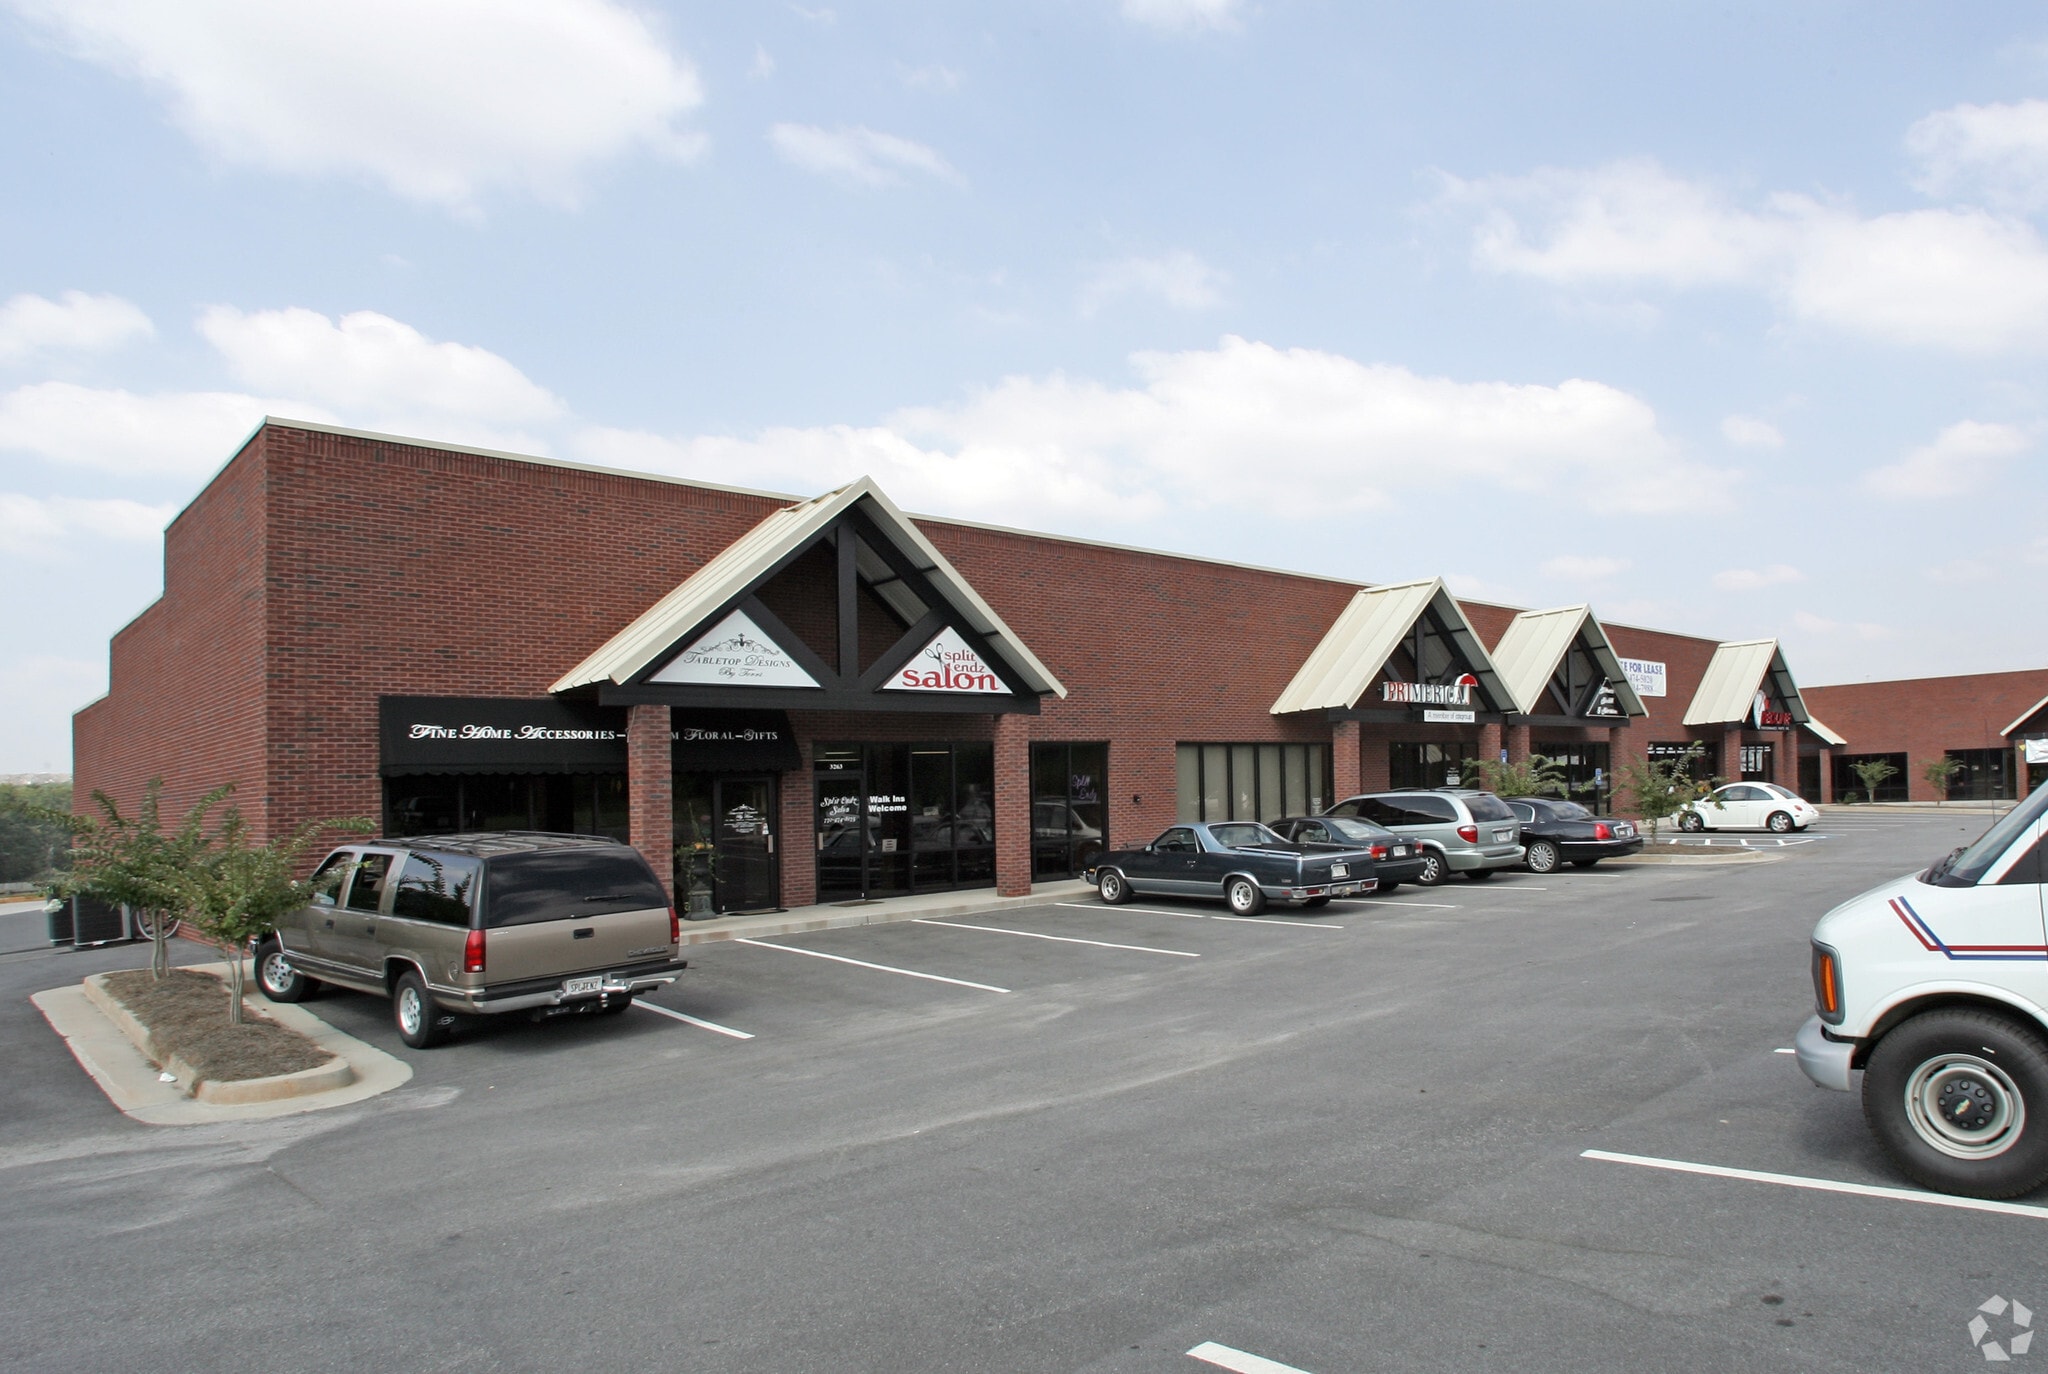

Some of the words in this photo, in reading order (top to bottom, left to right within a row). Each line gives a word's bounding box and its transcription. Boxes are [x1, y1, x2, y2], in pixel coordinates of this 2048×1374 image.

[683, 651, 741, 665] TABLETOP
[744, 655, 791, 667] DESIGNS
[944, 649, 976, 663] split
[719, 667, 736, 679] By
[954, 662, 985, 673] endz
[1629, 662, 1642, 673] FOR
[1643, 664, 1663, 675] LEASE
[902, 663, 999, 690] salon
[1383, 682, 1471, 704] PRIMERICA
[409, 724, 457, 739] FINE
[459, 725, 512, 739] HOME
